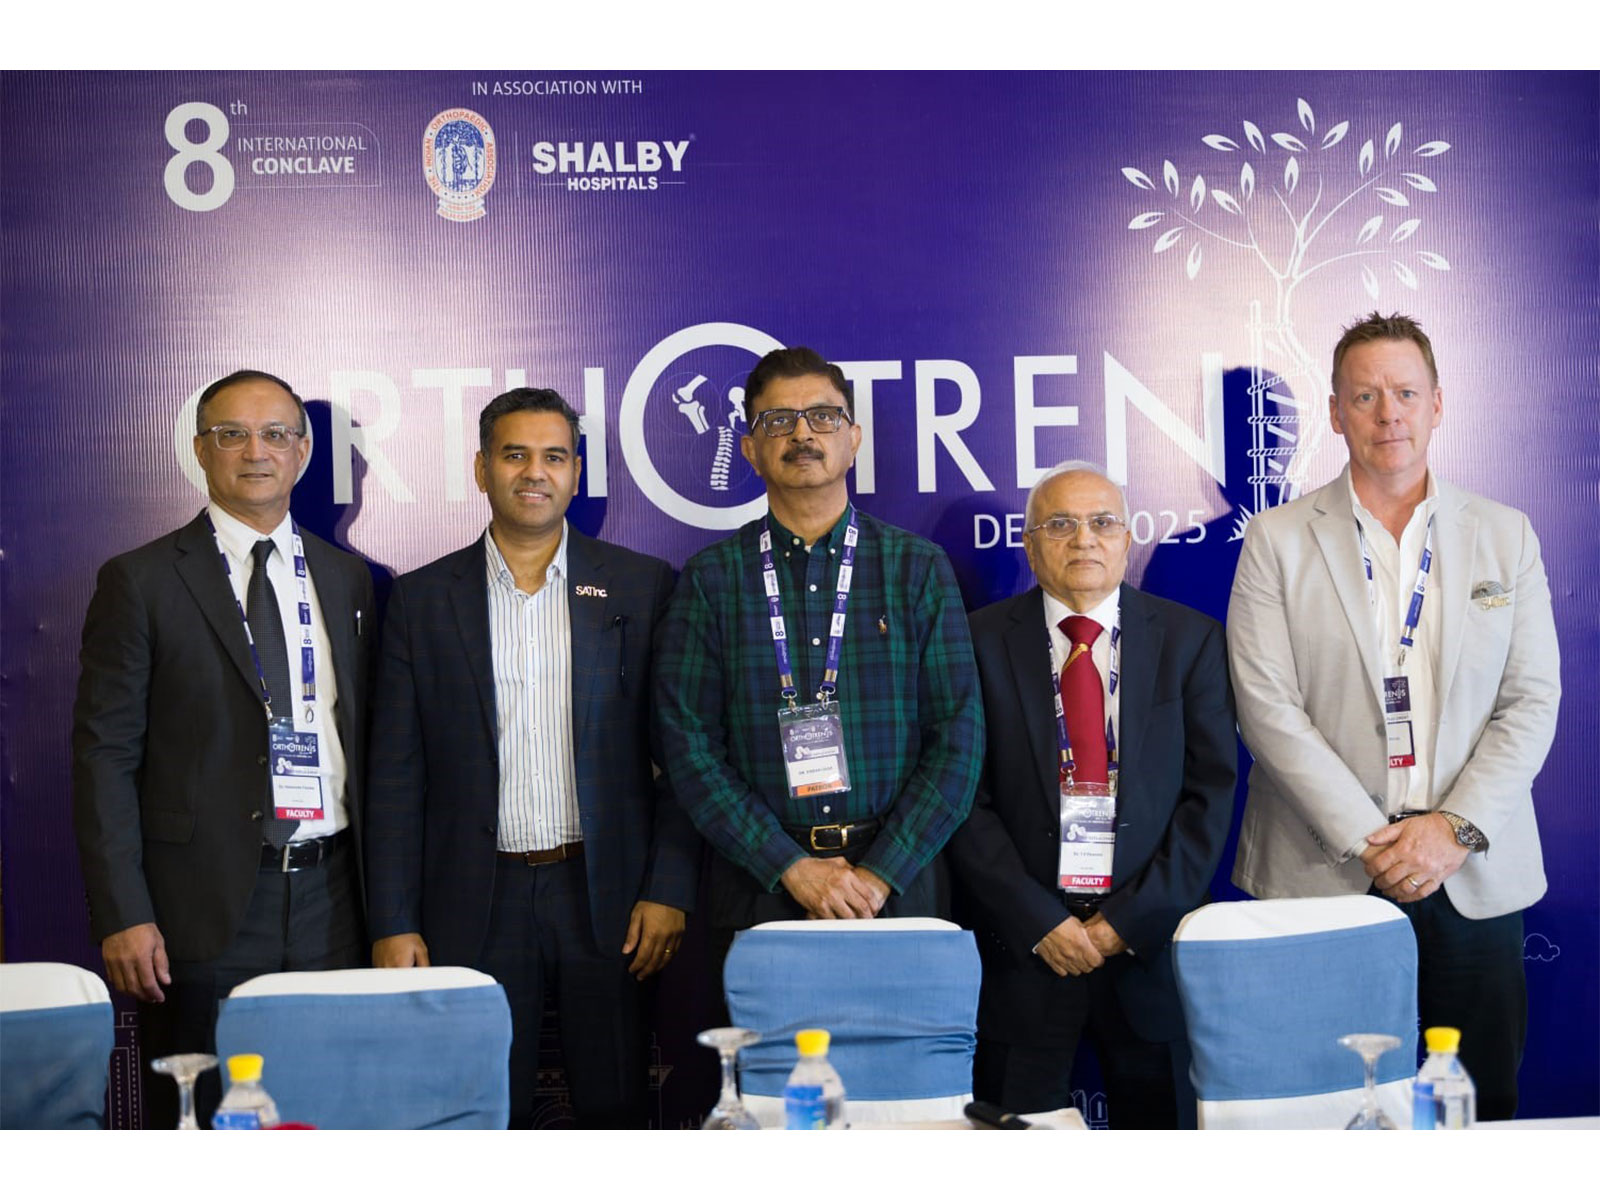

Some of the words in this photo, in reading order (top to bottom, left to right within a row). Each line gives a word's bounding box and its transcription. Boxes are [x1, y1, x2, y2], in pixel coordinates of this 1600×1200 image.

[472, 82, 488, 95] IN
[493, 81, 597, 95] ASSOCIATION
[601, 80, 643, 94] WITH
[237, 136, 367, 152] INTERNATIONAL
[164, 102, 235, 212] 8
[230, 100, 247, 115] th
[532, 141, 690, 174] SHALBY
[252, 157, 354, 174] CONCLAVE
[567, 176, 659, 191] HOSPITALS
[1131, 509, 1207, 545] 025
[285, 809, 315, 818] FACULTY
[1071, 876, 1105, 885] FACULTY
